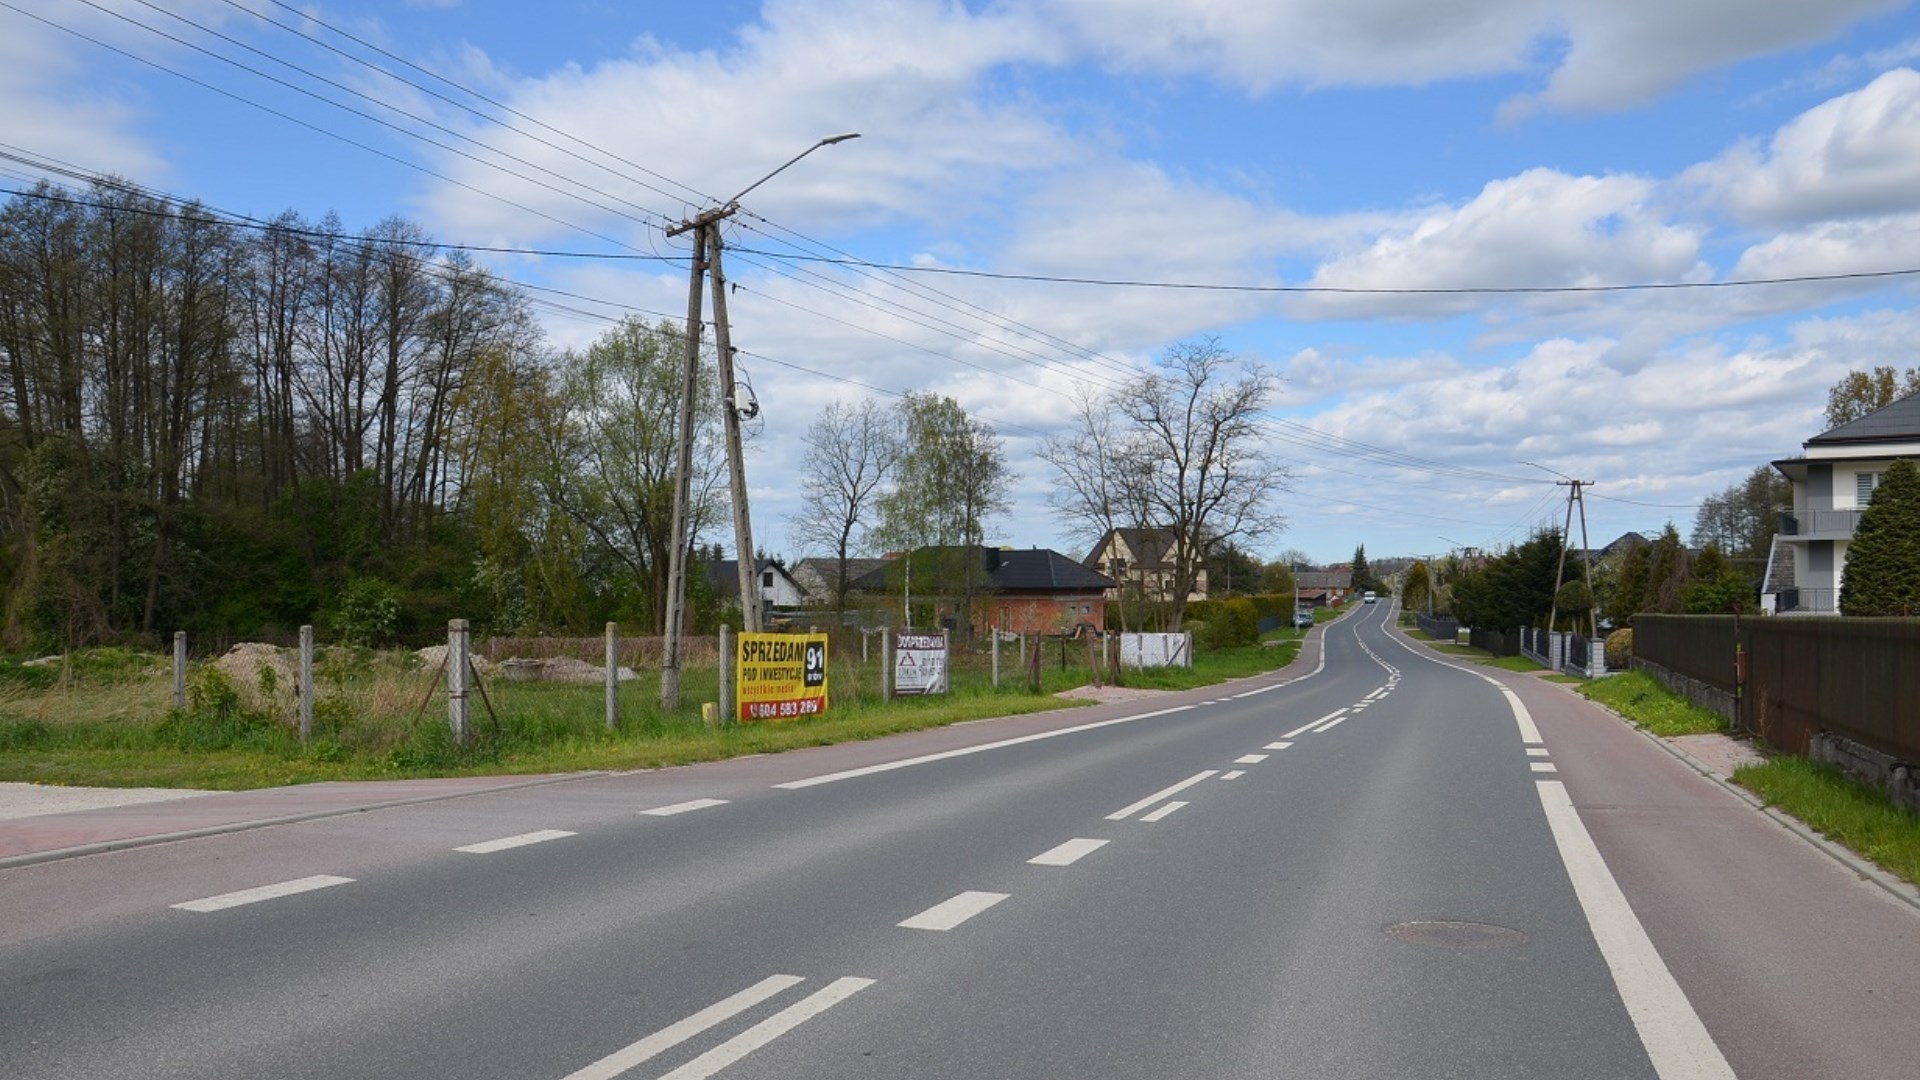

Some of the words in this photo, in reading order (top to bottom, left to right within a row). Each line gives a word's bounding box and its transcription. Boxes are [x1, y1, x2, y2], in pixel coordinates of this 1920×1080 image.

[742, 640, 804, 662] SPRZEDAM
[806, 647, 824, 670] 91
[742, 667, 757, 681] POD
